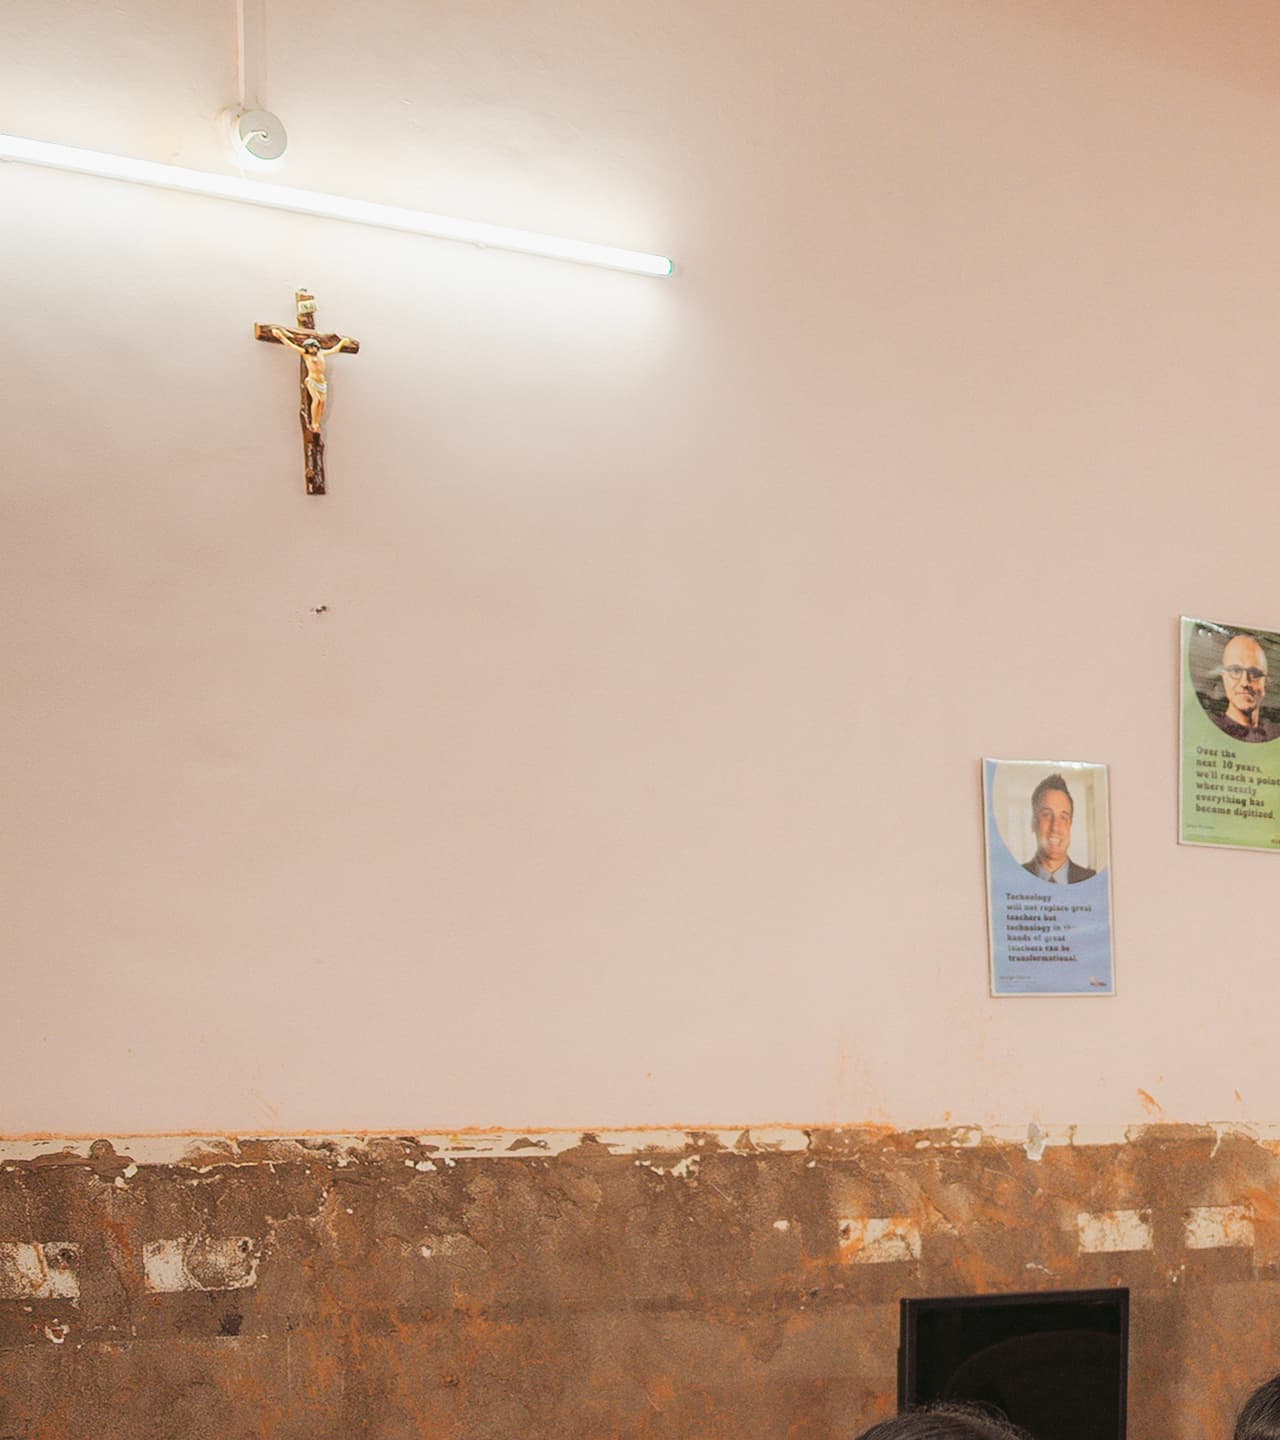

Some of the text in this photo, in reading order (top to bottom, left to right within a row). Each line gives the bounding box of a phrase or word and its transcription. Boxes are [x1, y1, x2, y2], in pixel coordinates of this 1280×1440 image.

[1196, 746, 1236, 758] Over the
[1222, 760, 1233, 769] 10
[1220, 773, 1246, 783] reach
[1256, 776, 1280, 787] point
[1196, 782, 1224, 791] where
[1196, 793, 1265, 807] everything has
